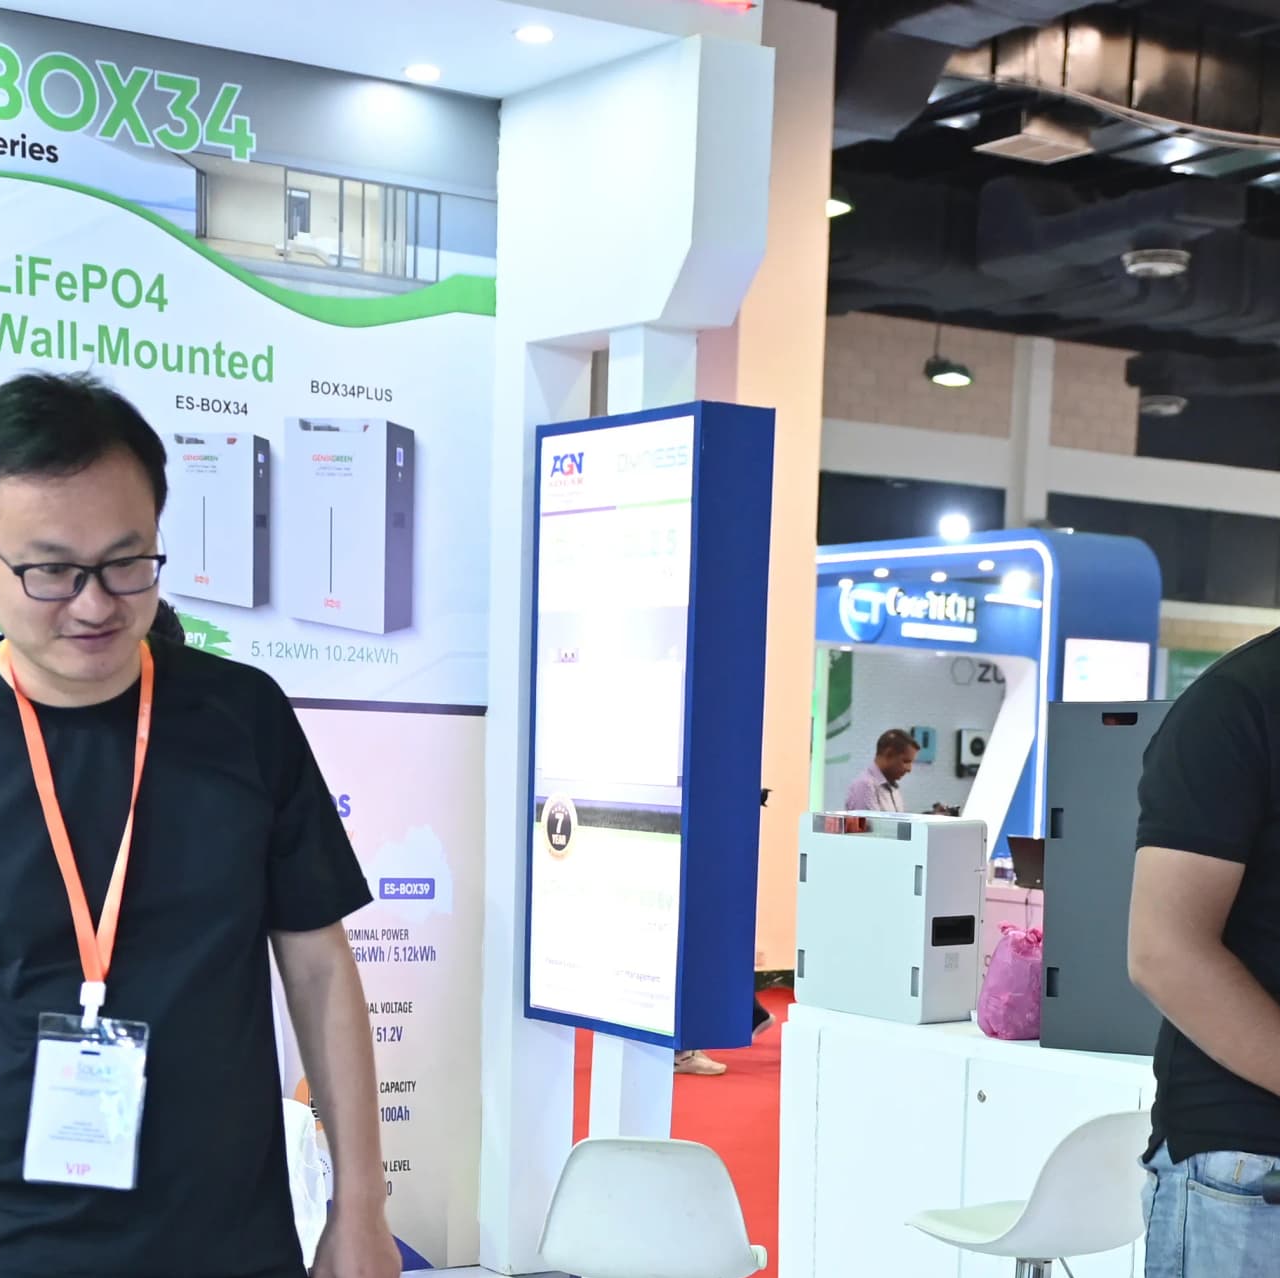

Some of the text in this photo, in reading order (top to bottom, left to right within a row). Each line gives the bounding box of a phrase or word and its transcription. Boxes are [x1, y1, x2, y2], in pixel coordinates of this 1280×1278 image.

[311, 380, 393, 403] BOX34PLUS
[175, 395, 248, 416] ES-BOX34
[550, 452, 584, 477] AGN
[251, 640, 399, 665] 5.12kWh 10.24kWh
[554, 812, 564, 834] 7
[384, 883, 430, 895] ES-BOX39
[346, 928, 409, 941] OMINAL POWER
[394, 945, 437, 965] 5.12kWh
[381, 1001, 413, 1014] VOLTAGE
[376, 1026, 403, 1042] 51.2V
[380, 1081, 416, 1094] CAPACITY
[381, 1106, 410, 1122] 100Ah
[66, 1162, 91, 1177] VIP
[390, 1160, 411, 1172] LEVEL
